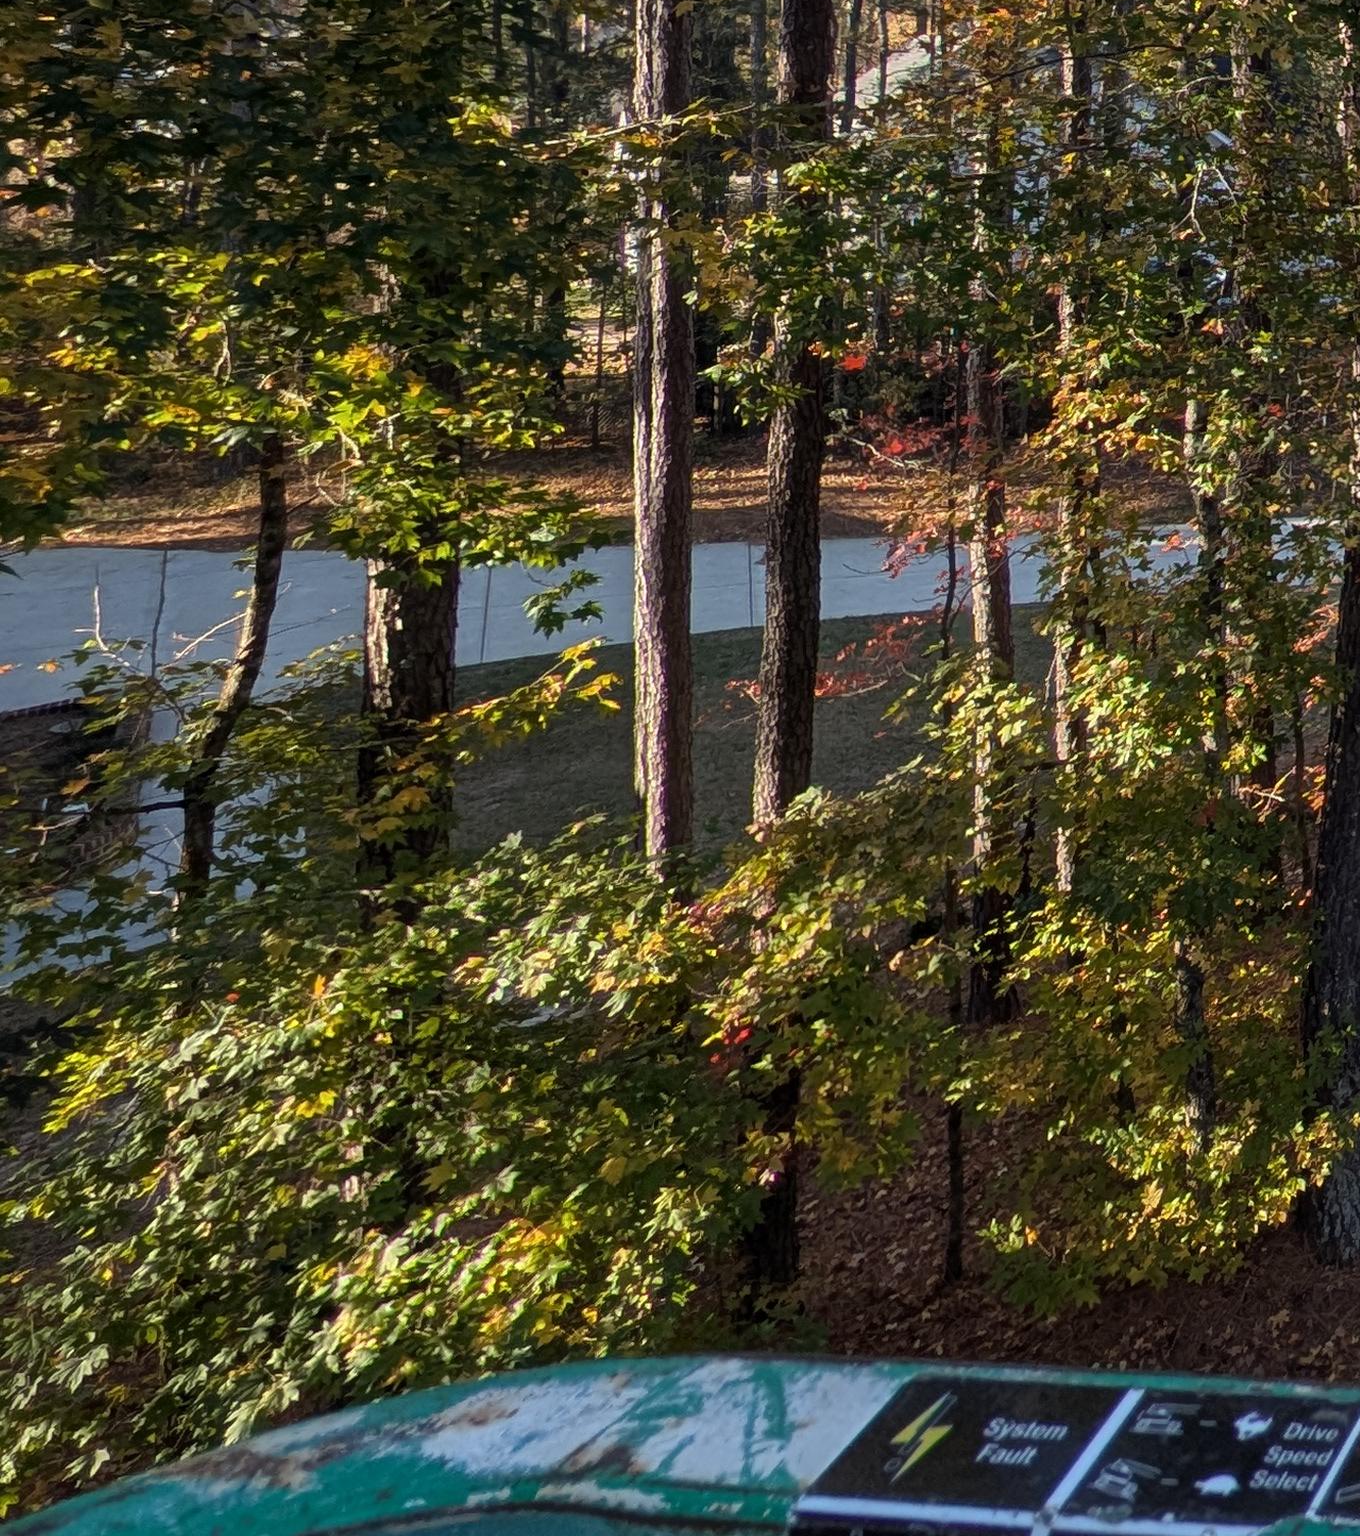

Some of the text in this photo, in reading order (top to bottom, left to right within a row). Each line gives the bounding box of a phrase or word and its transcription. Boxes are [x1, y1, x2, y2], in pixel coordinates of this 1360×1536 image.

[983, 1418, 1068, 1442] System
[1282, 1422, 1340, 1443] Drive
[975, 1443, 1038, 1465] Fault
[1263, 1445, 1333, 1466] Speed
[1249, 1470, 1320, 1492] Select
